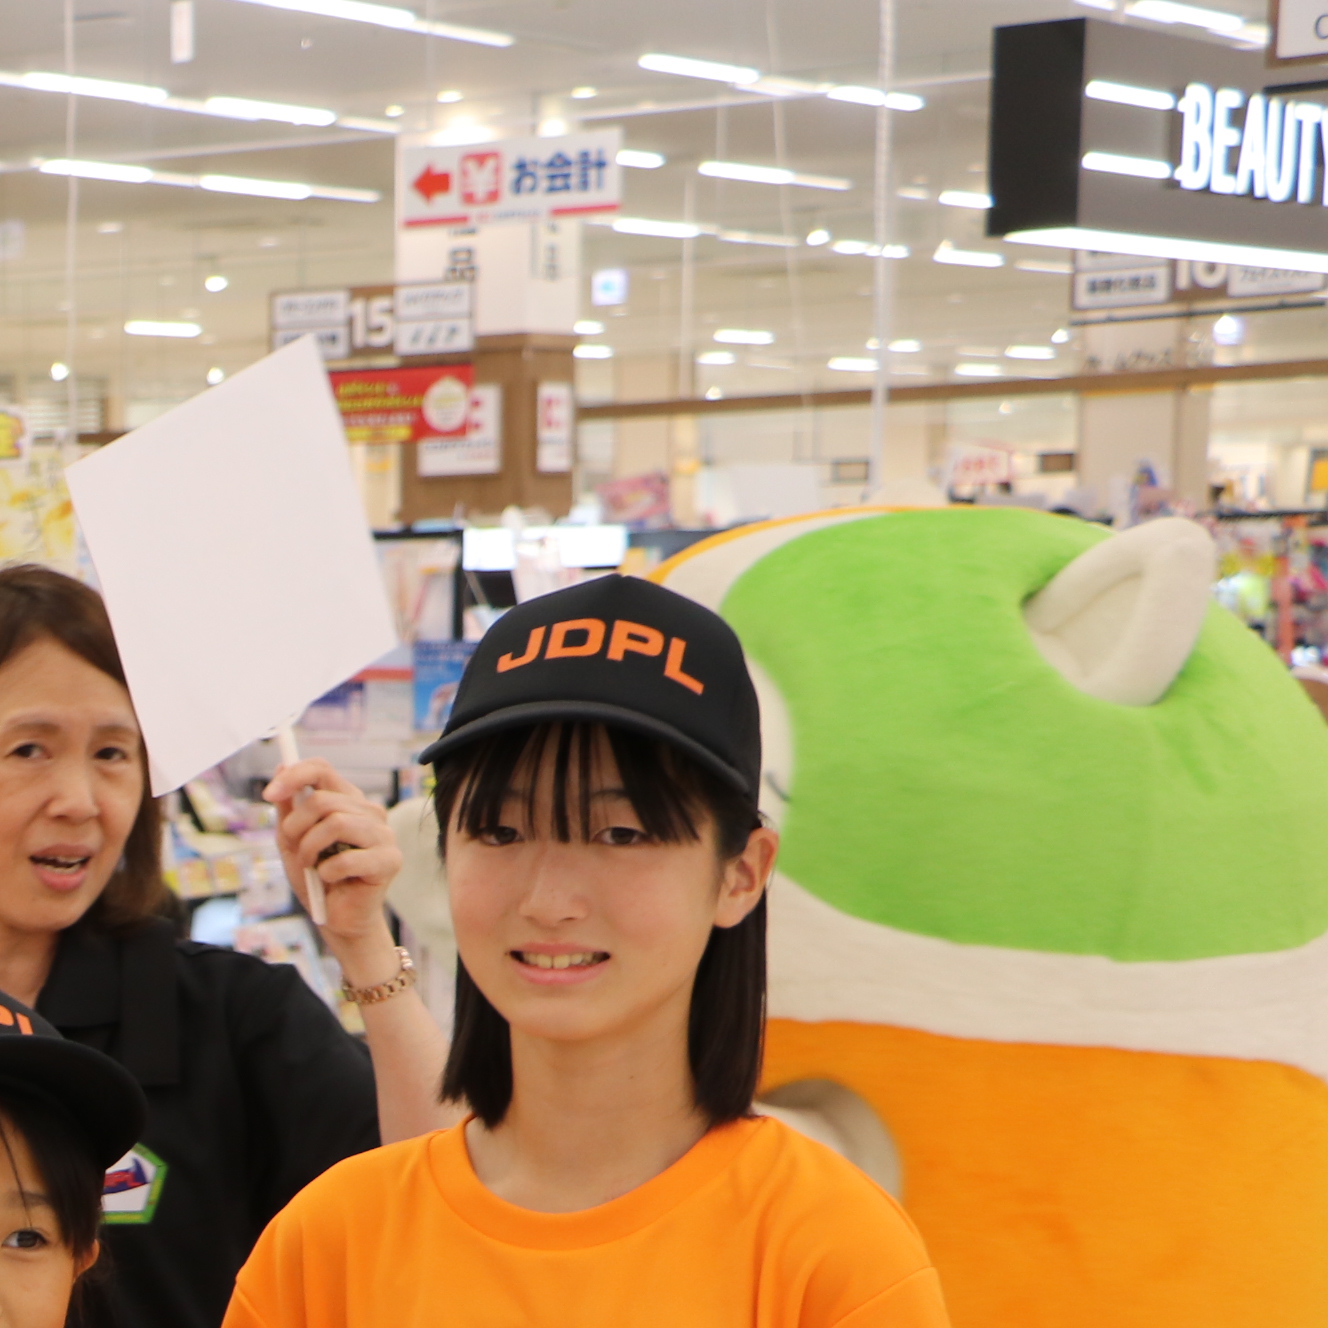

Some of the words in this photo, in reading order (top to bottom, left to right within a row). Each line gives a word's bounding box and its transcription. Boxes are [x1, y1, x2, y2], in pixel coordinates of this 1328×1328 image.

[510, 148, 608, 196] お会計
[349, 296, 393, 348] 15
[496, 617, 705, 696] JDPL
